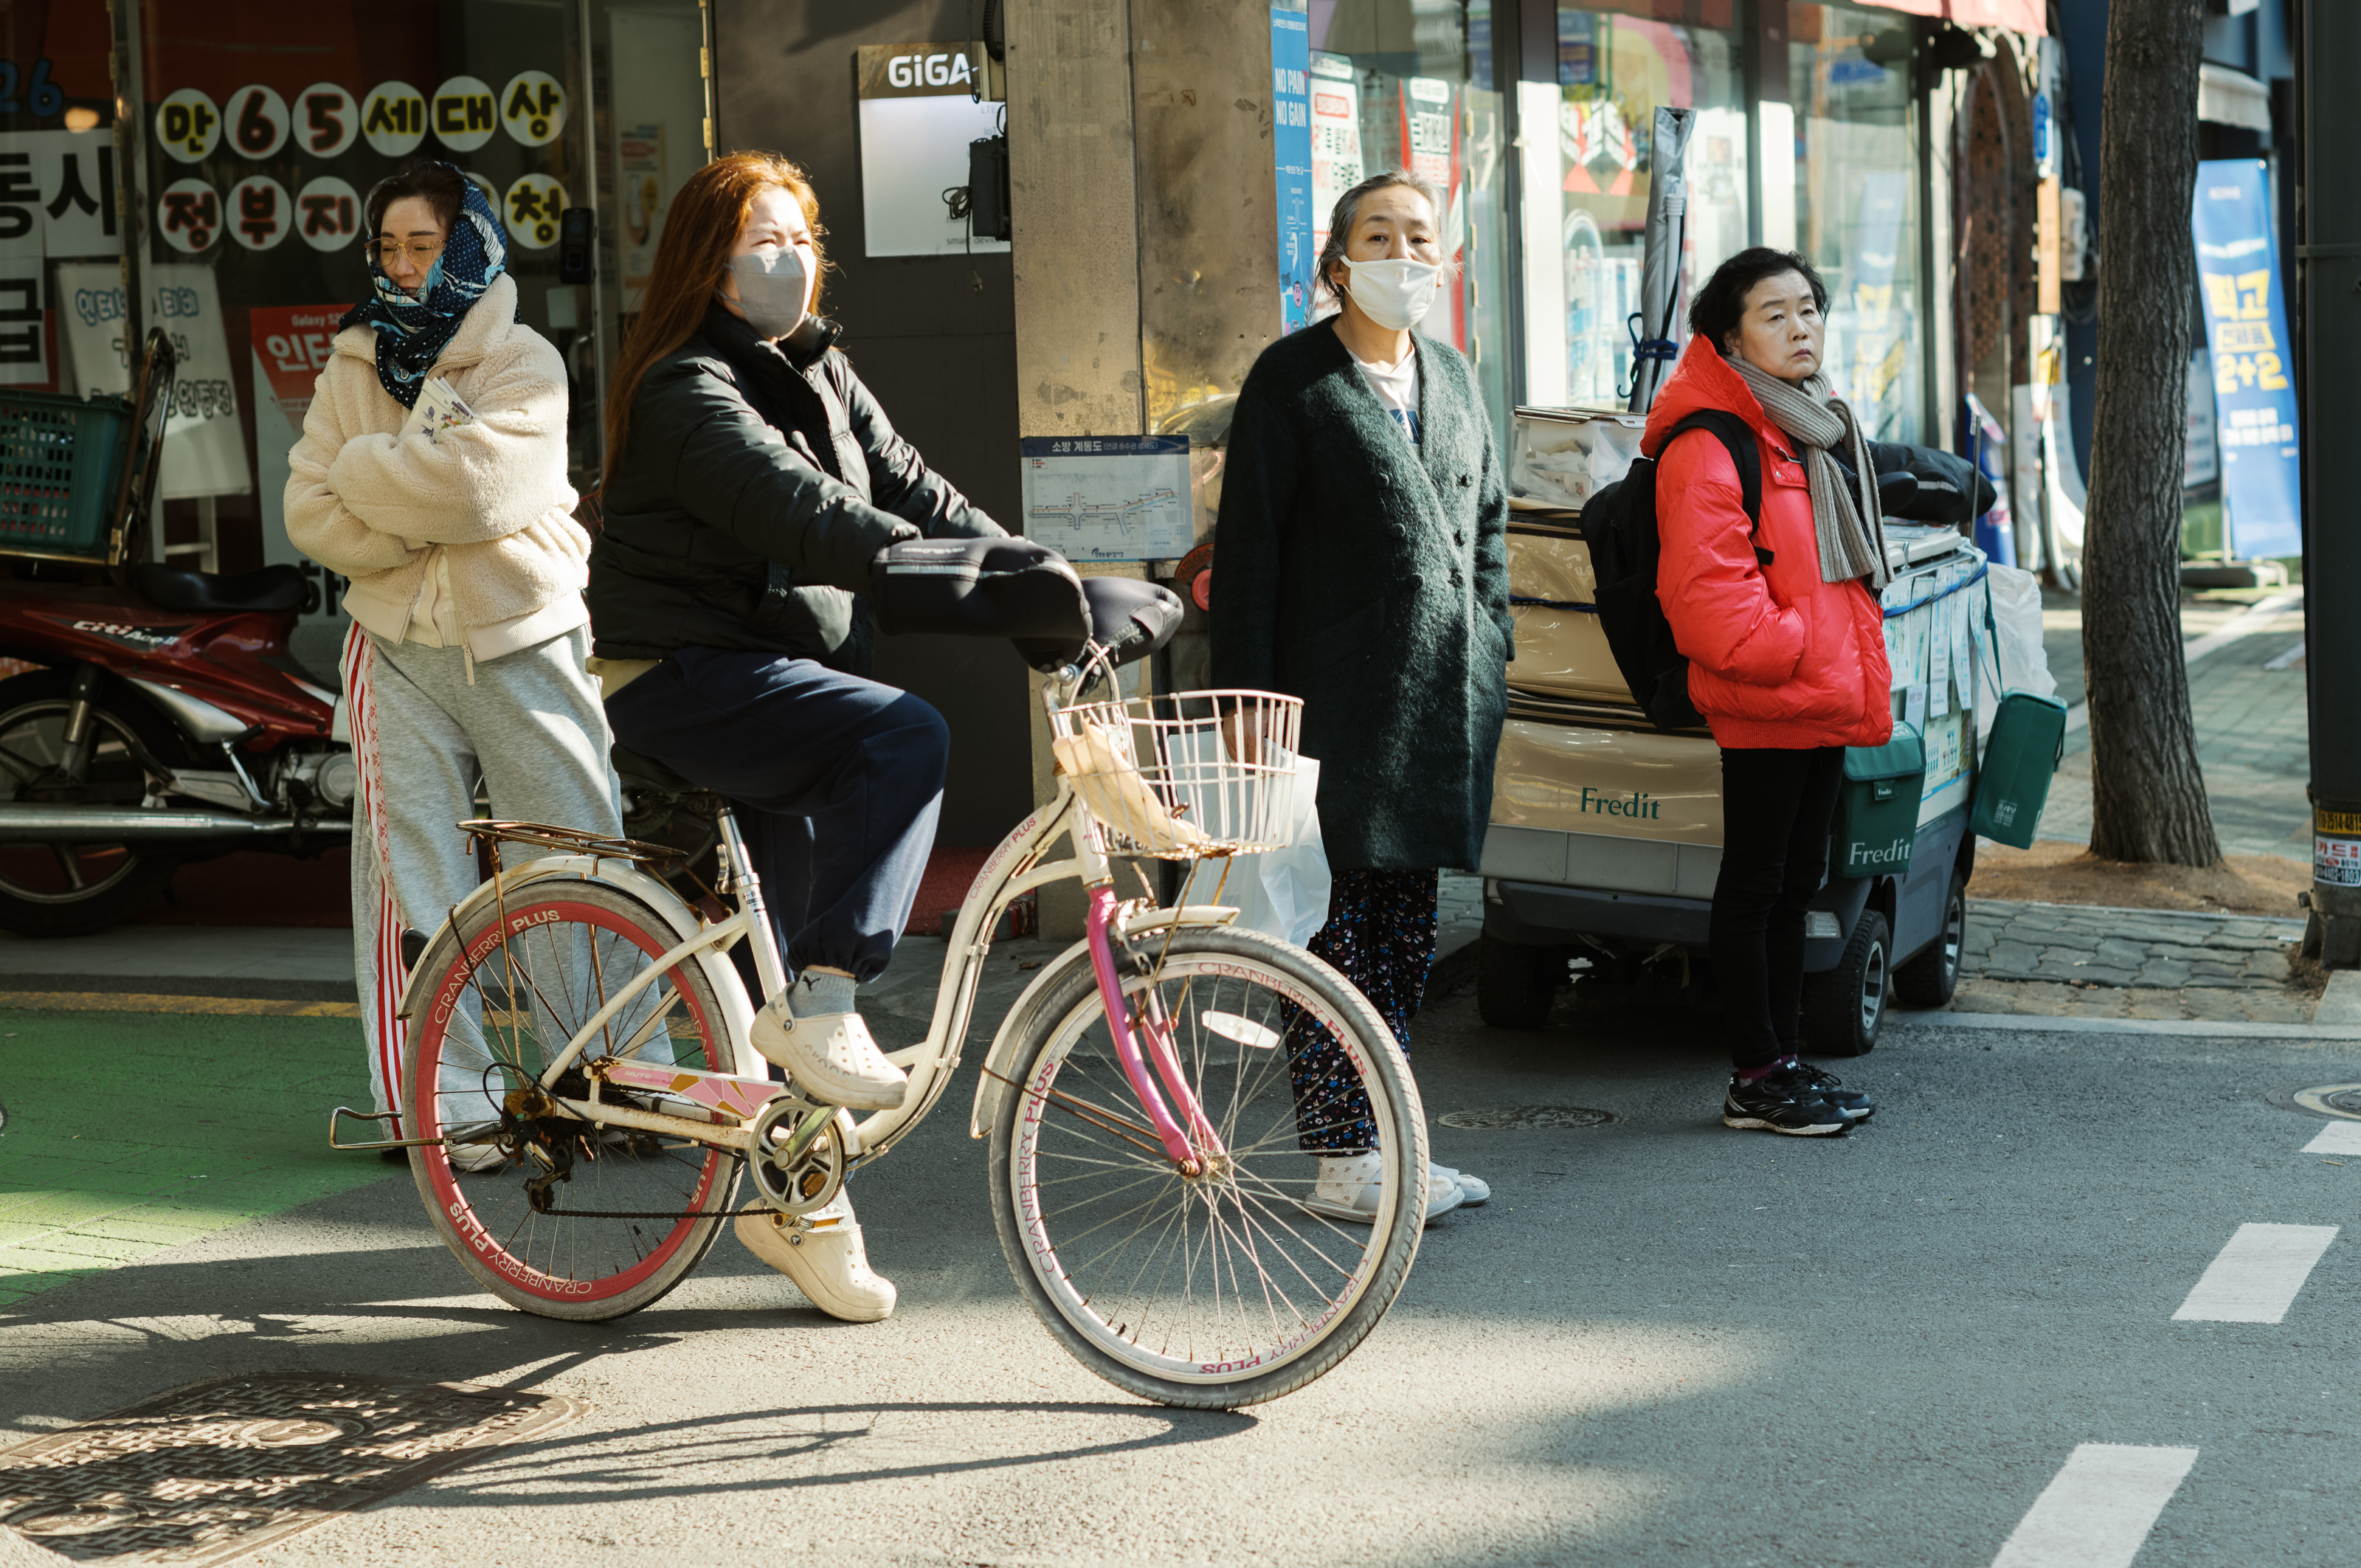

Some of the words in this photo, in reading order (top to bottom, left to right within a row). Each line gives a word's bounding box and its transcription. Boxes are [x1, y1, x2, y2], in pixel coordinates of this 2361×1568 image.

[888, 53, 978, 88] GiGA
[1275, 67, 1287, 93] NO
[1276, 100, 1287, 125] NO
[1288, 101, 1306, 128] GAIN
[2216, 351, 2289, 393] 2+2
[1051, 441, 1071, 452] 소방
[1074, 441, 1103, 452] 계통도
[1580, 787, 1661, 820] Fredit
[969, 839, 1012, 899] CRANBERRY
[1012, 817, 1036, 843] PLUS
[1848, 837, 1912, 866] Fredit
[511, 909, 561, 931] PLUS
[1198, 962, 1324, 1015] CRANBERRY
[1326, 1019, 1368, 1076] PLUS
[1025, 1062, 1054, 1124] PLUS
[533, 1154, 551, 1172] SHIMANO
[1019, 1131, 1054, 1273] CRANBERRY
[449, 1201, 490, 1253] PLUS
[487, 1251, 592, 1294] CRANBERRY
[1269, 1259, 1369, 1361] CRANBERRY
[1200, 1355, 1260, 1373] PLUS
